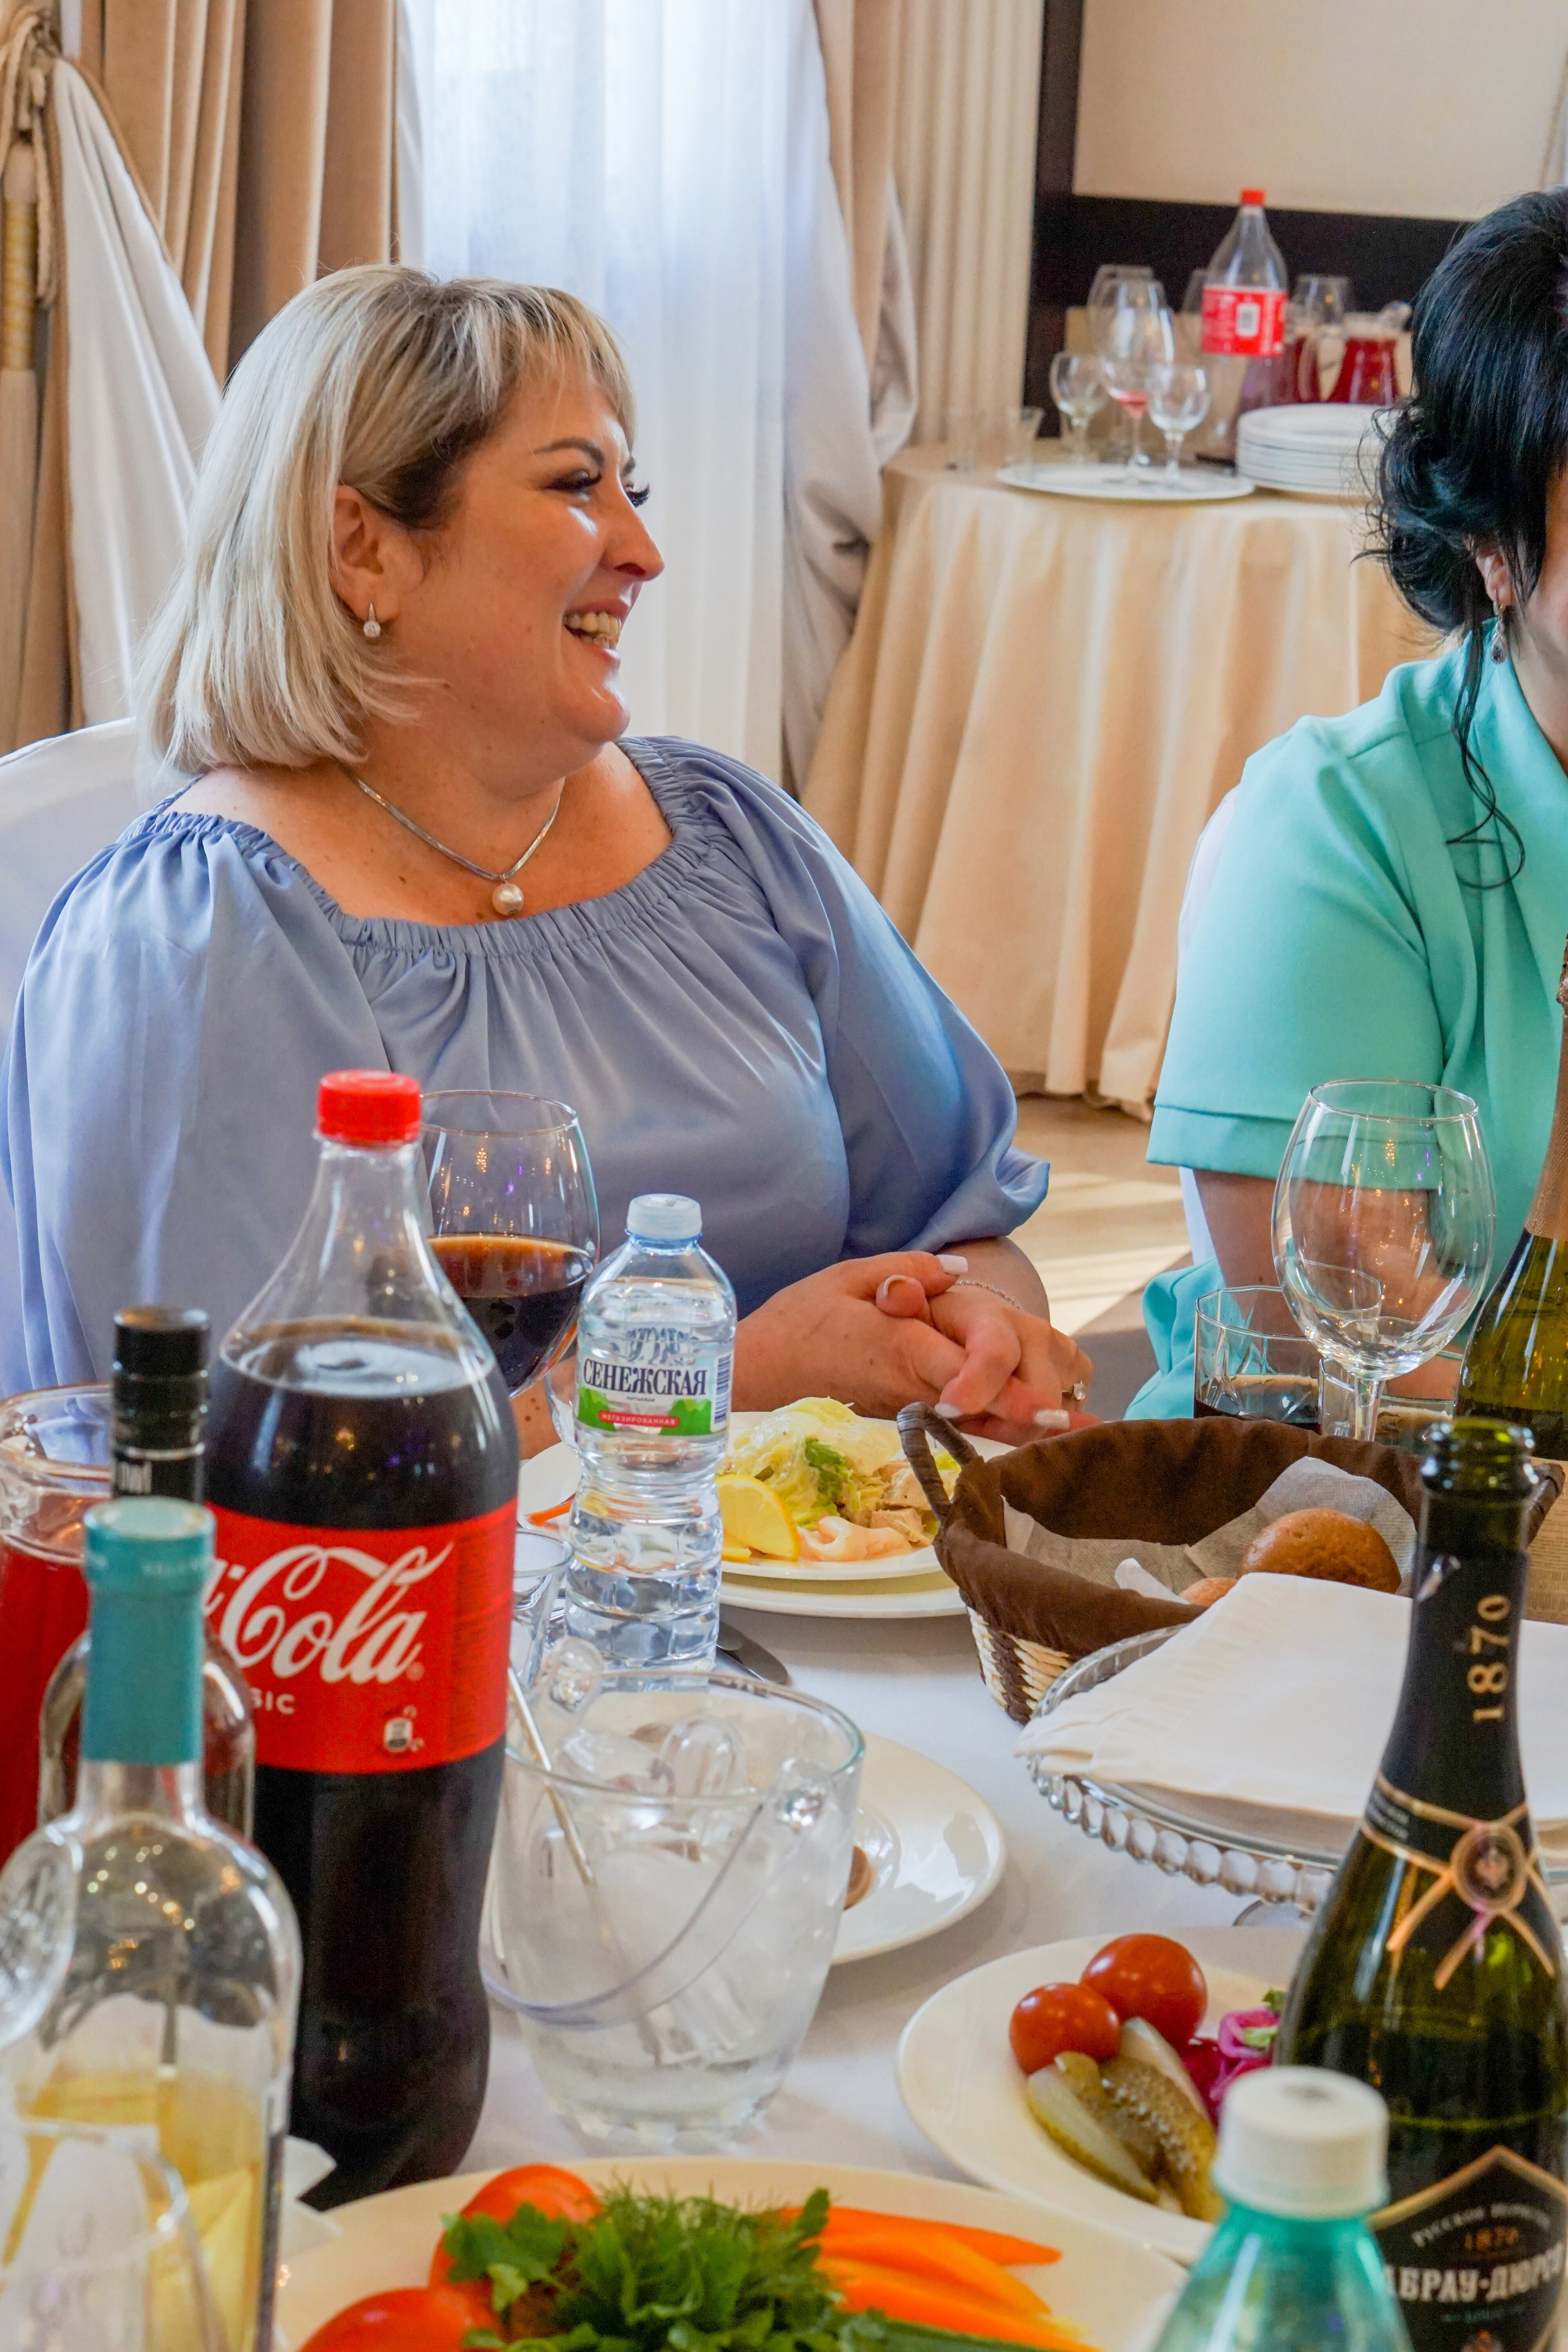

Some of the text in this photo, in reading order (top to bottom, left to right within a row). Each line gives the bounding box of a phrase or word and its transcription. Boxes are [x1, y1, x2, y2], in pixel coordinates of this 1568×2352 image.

[584, 1358, 708, 1396] СЕНЕЖСКАЯ
[601, 1413, 675, 1425] НЕГАЗИРОВАННАЯ
[1467, 1594, 1512, 1722] 1870
